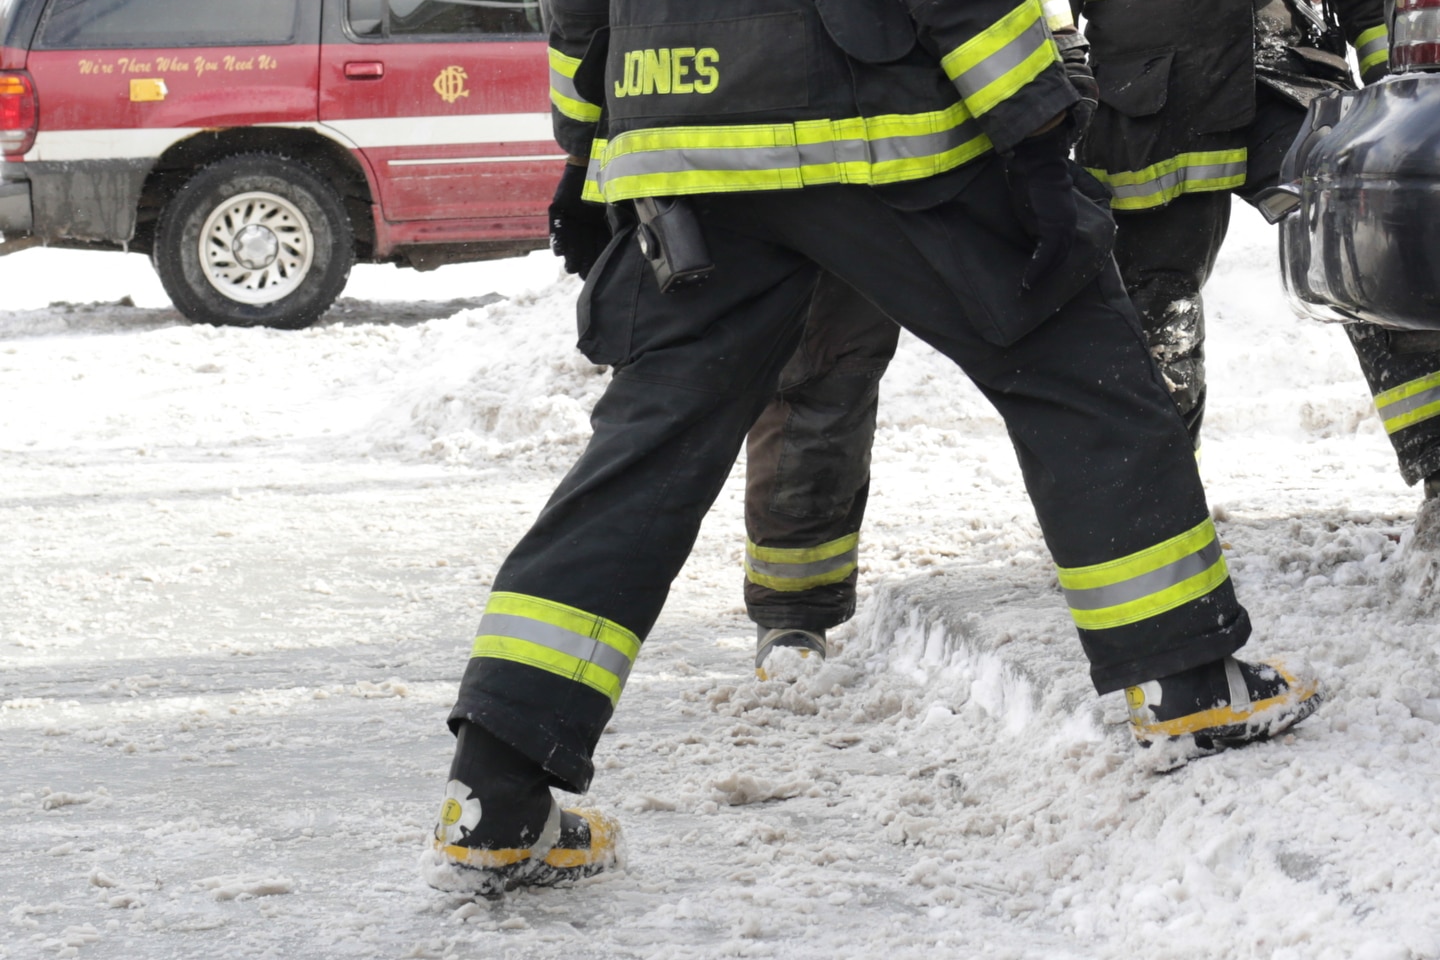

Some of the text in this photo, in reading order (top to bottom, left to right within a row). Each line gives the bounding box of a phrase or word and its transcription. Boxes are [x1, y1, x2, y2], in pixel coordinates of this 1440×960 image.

[78, 54, 277, 77] We're There When You Need Us
[614, 47, 720, 98] JONES
